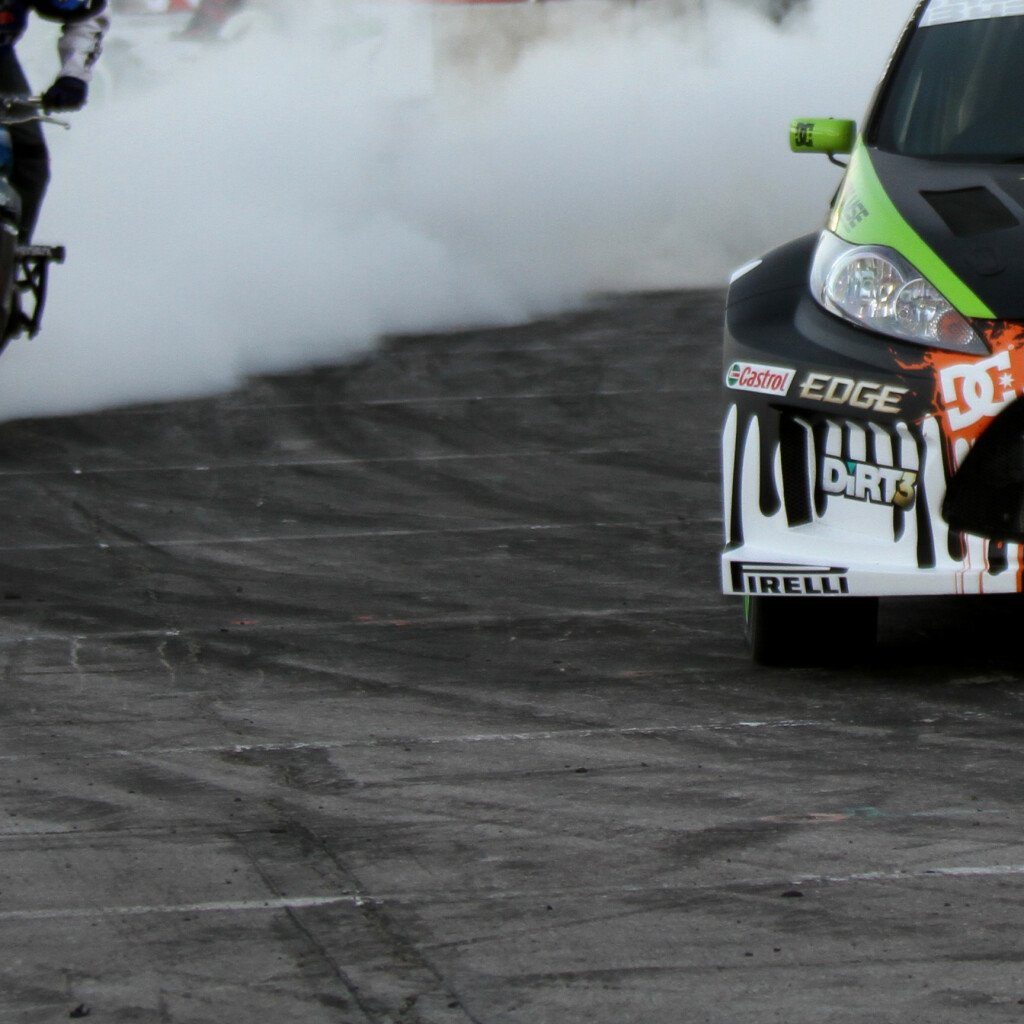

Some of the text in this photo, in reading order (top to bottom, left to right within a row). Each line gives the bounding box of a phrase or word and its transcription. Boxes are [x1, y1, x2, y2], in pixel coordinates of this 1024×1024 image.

[737, 366, 909, 413] Castrol EDGE
[730, 560, 849, 593] PIRELLI
